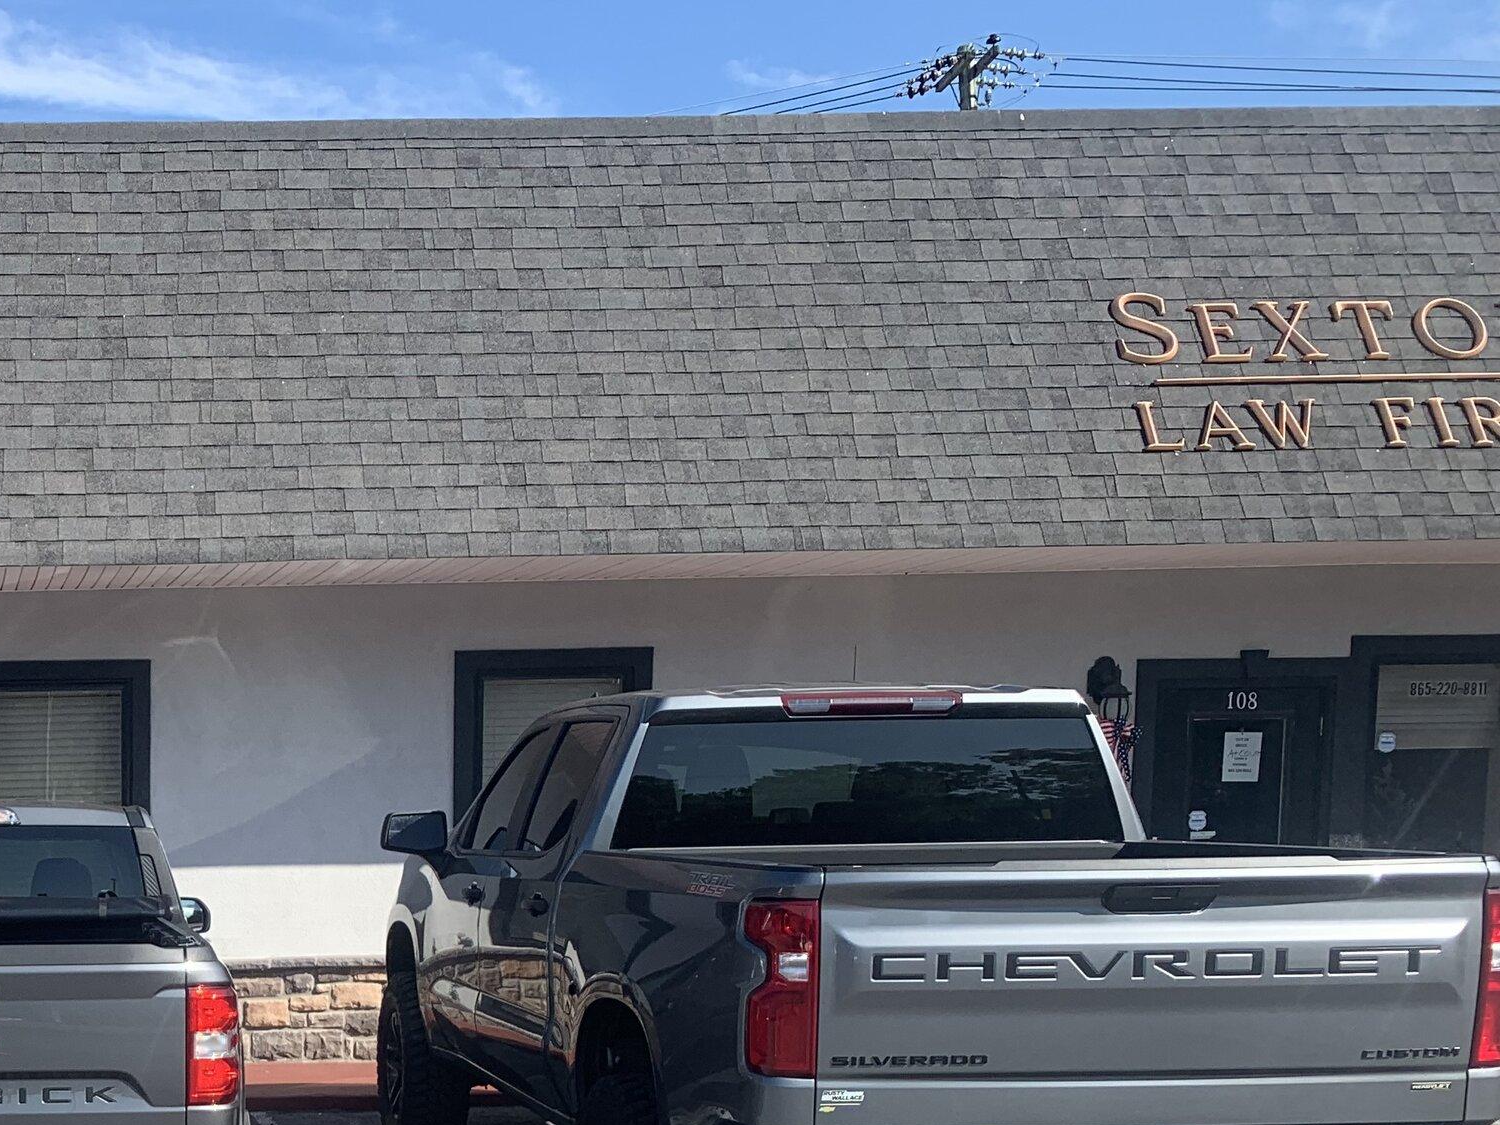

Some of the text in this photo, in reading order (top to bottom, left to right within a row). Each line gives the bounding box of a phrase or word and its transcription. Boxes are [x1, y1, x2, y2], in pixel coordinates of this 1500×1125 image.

[1108, 292, 1500, 365] SEXTO
[1135, 398, 1316, 453] LAW
[1409, 681, 1488, 696] 865-220-8811
[1226, 690, 1259, 711] 108
[689, 871, 736, 889] TRAIL
[869, 944, 1444, 984] CHEVROLET
[830, 1053, 989, 1068] SILVERADO
[1360, 1047, 1461, 1061] CUSTOM
